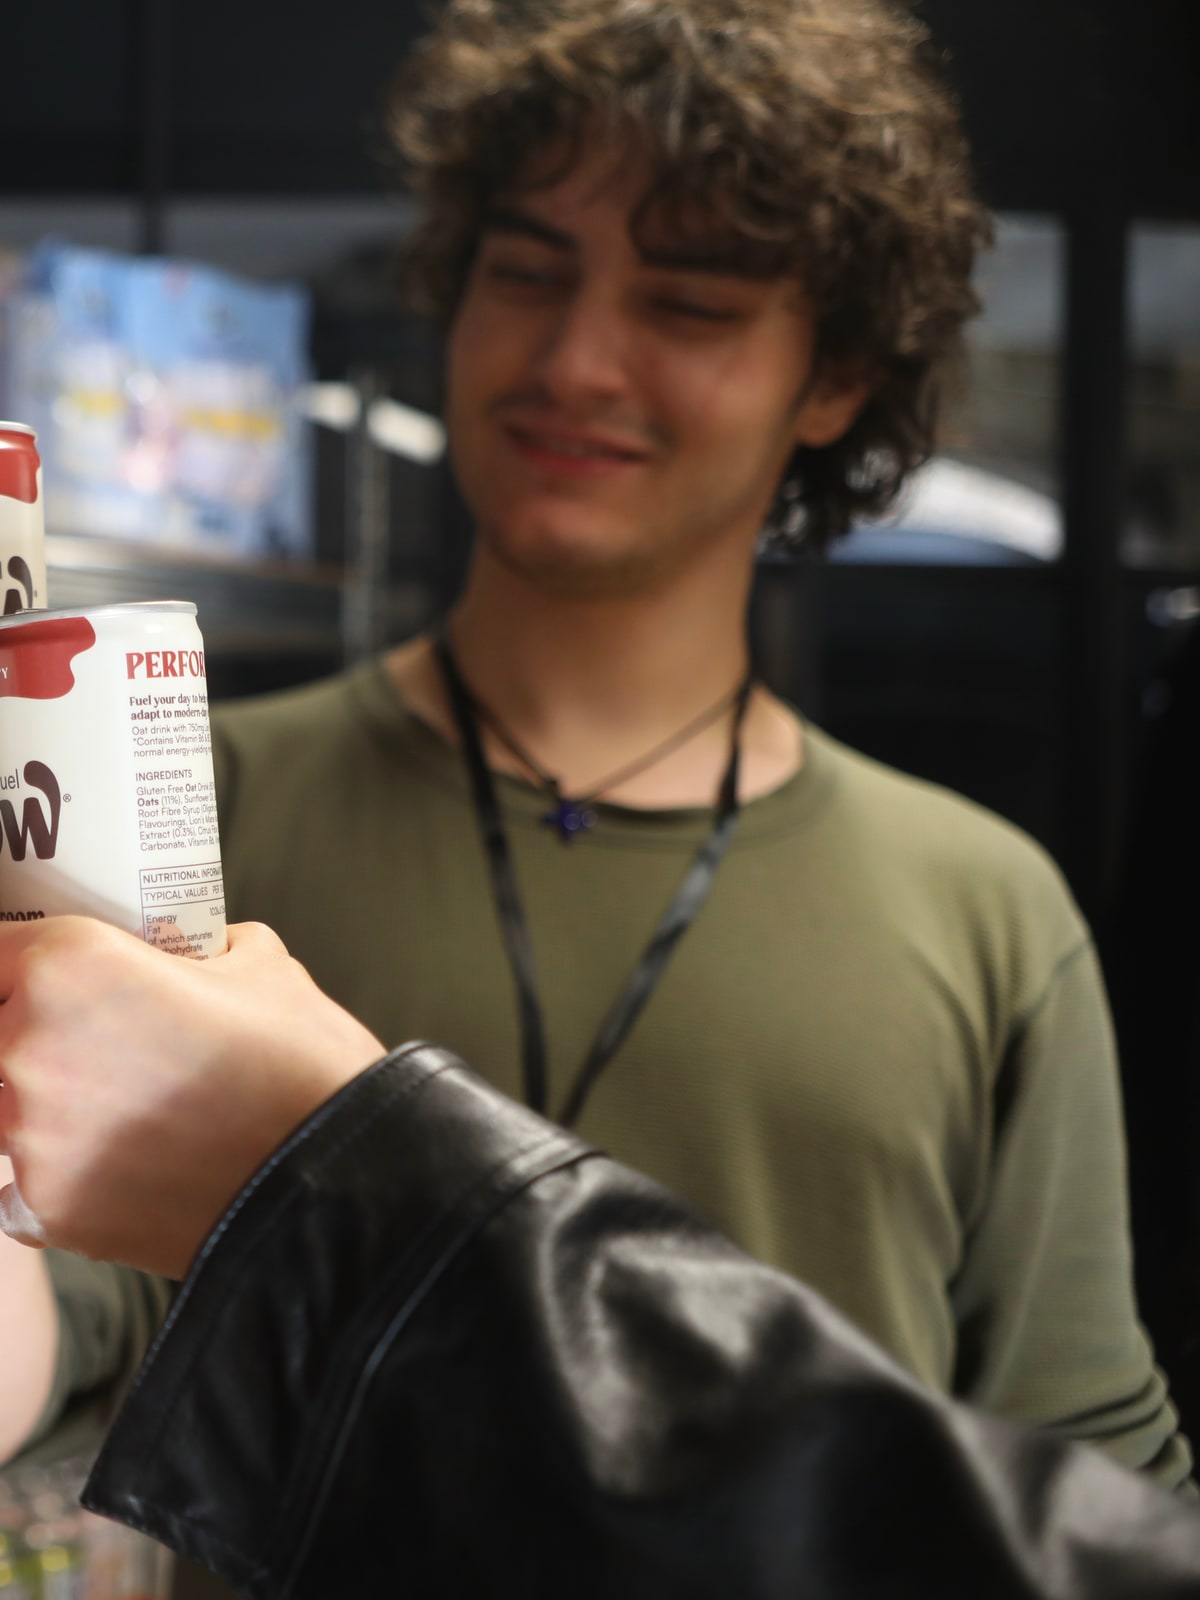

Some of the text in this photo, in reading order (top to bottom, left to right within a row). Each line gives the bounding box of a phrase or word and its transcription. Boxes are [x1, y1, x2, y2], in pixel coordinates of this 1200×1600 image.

[129, 695, 152, 706] Fuel
[154, 696, 176, 709] your
[177, 693, 191, 707] day
[131, 709, 160, 721] adapt
[163, 709, 172, 719] to
[132, 726, 148, 736] Oat
[150, 724, 171, 735] drink
[173, 724, 186, 733] with
[175, 734, 197, 744] Vitamin
[134, 748, 164, 758] normal
[136, 769, 193, 781] INGREDIENTS
[136, 785, 166, 797] Gluten
[168, 784, 184, 794] Free
[185, 783, 197, 793] Oat
[137, 798, 159, 807] Oats
[138, 808, 159, 818] Root
[161, 806, 181, 816] Fibre
[183, 805, 200, 817] Syrup
[139, 818, 188, 829] Flavourings,
[140, 830, 170, 840] Extract
[141, 841, 187, 852] Carbonate,
[143, 870, 200, 883] NUTRITIONAL
[144, 889, 182, 902] TYPICAL
[184, 886, 208, 899] VALUES
[146, 914, 177, 924] Energy
[147, 926, 161, 935] Fat
[160, 934, 185, 945] which
